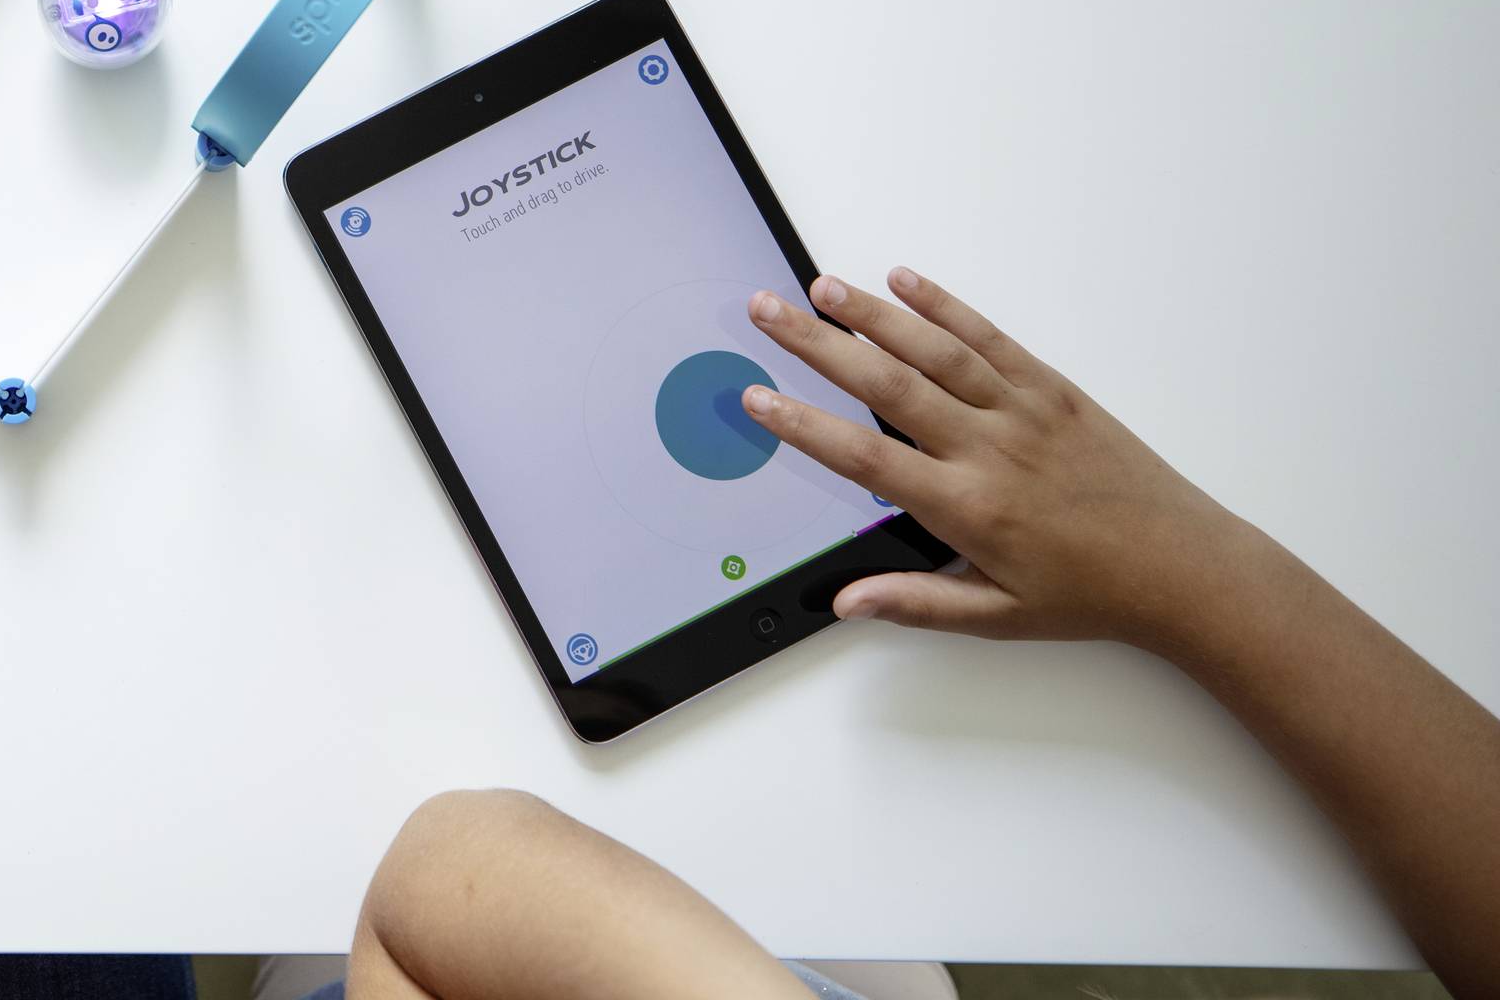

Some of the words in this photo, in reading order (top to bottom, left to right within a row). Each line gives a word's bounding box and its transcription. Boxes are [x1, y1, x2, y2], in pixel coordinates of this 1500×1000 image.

[452, 130, 597, 217] JOYSTICK
[460, 213, 501, 242] Touch
[503, 199, 526, 223] and
[528, 187, 558, 210] drag
[557, 179, 572, 194] to
[573, 160, 610, 186] drive.
